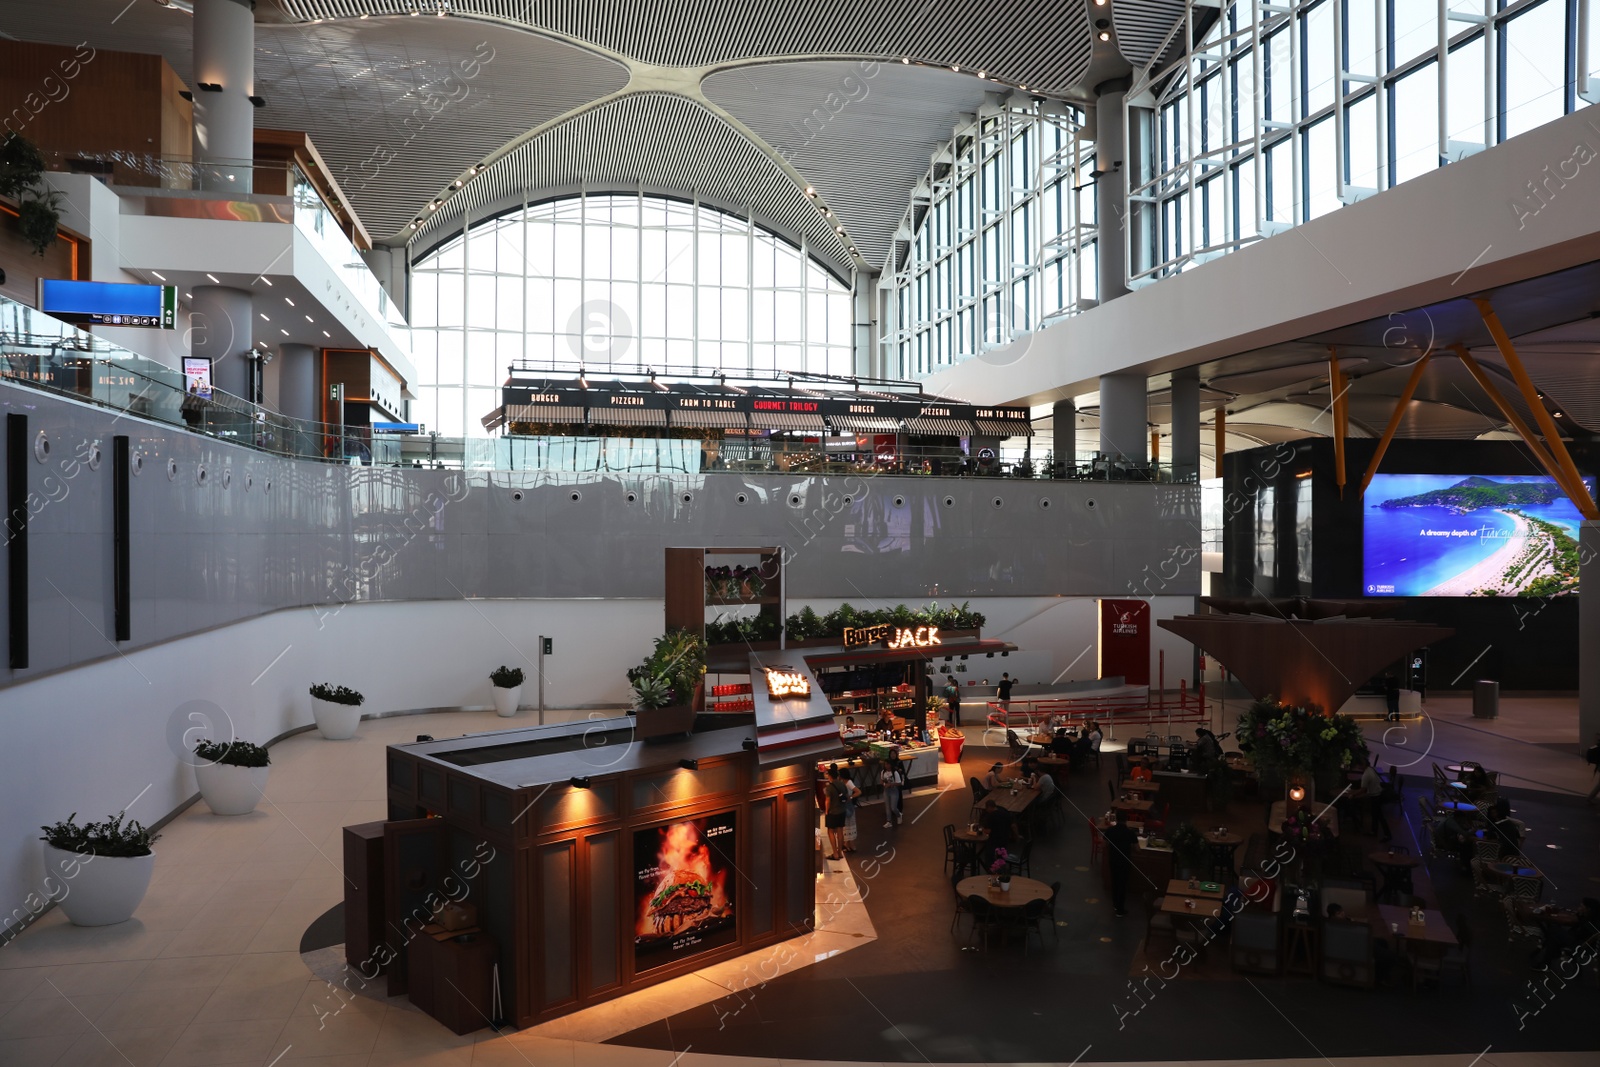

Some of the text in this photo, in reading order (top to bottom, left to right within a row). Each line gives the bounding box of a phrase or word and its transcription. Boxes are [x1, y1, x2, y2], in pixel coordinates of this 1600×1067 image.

[531, 393, 559, 403] BURGER
[611, 396, 644, 405] PIZZERIA
[680, 398, 736, 409] FARM TO TABLE
[753, 400, 818, 411] GOURMET TRILOGY
[849, 404, 875, 413] BURGER
[920, 407, 950, 416] PIZZERIA
[976, 409, 1025, 419] FARM TO TABLE
[1426, 529, 1450, 538] dreamy
[1451, 529, 1469, 538] depth
[888, 627, 941, 649] JACK
